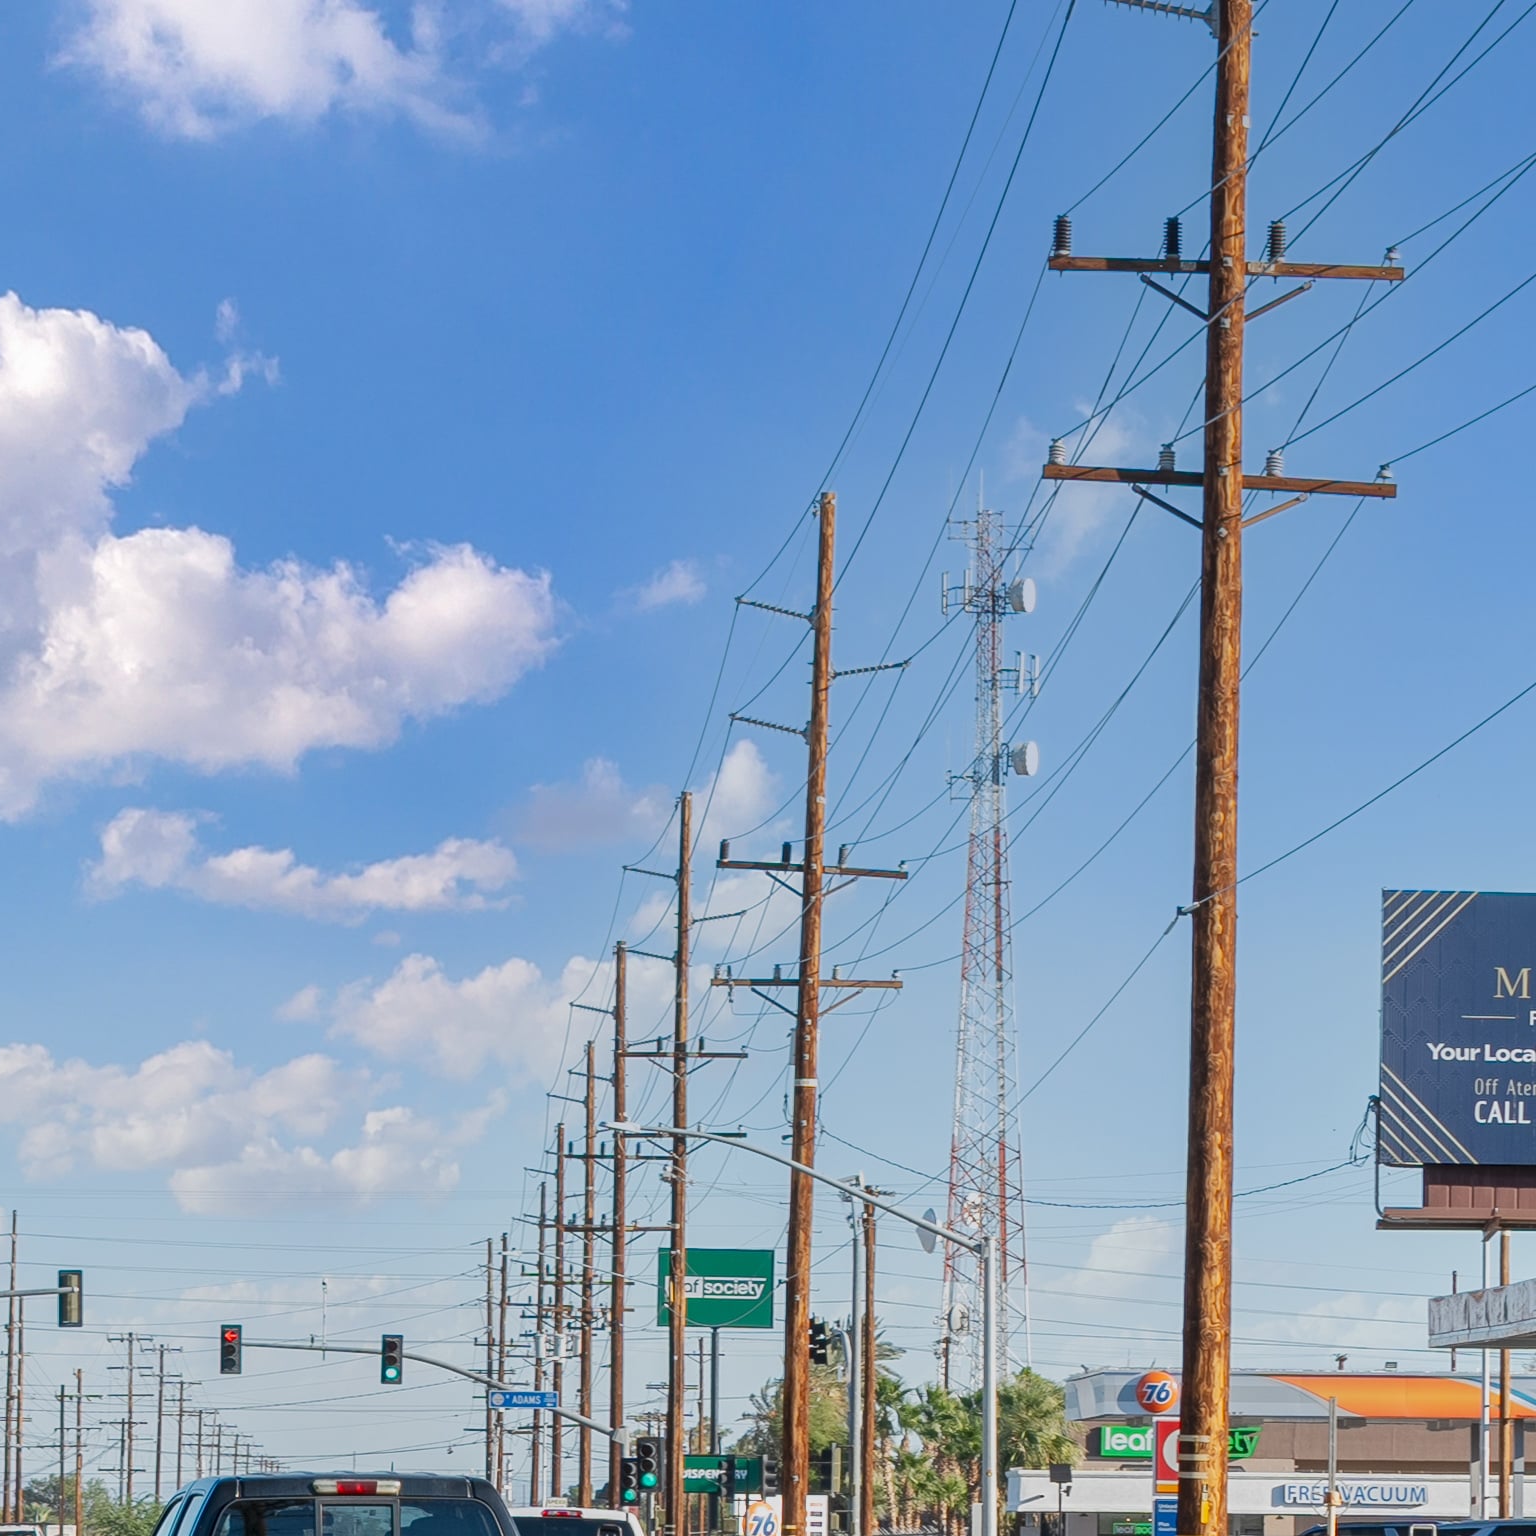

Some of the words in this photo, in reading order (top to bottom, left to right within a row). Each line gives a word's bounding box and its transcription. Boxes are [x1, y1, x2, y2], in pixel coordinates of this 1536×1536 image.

[1427, 1043, 1481, 1062] Your
[1474, 1078, 1498, 1096] Off
[1474, 1100, 1531, 1125] CALL
[704, 1280, 765, 1299] society
[511, 1394, 542, 1405] ADAMS
[1141, 1381, 1172, 1404] 76
[1104, 1426, 1153, 1451] leaf
[1339, 1486, 1426, 1503] VACUUM
[751, 1512, 775, 1536] 76
